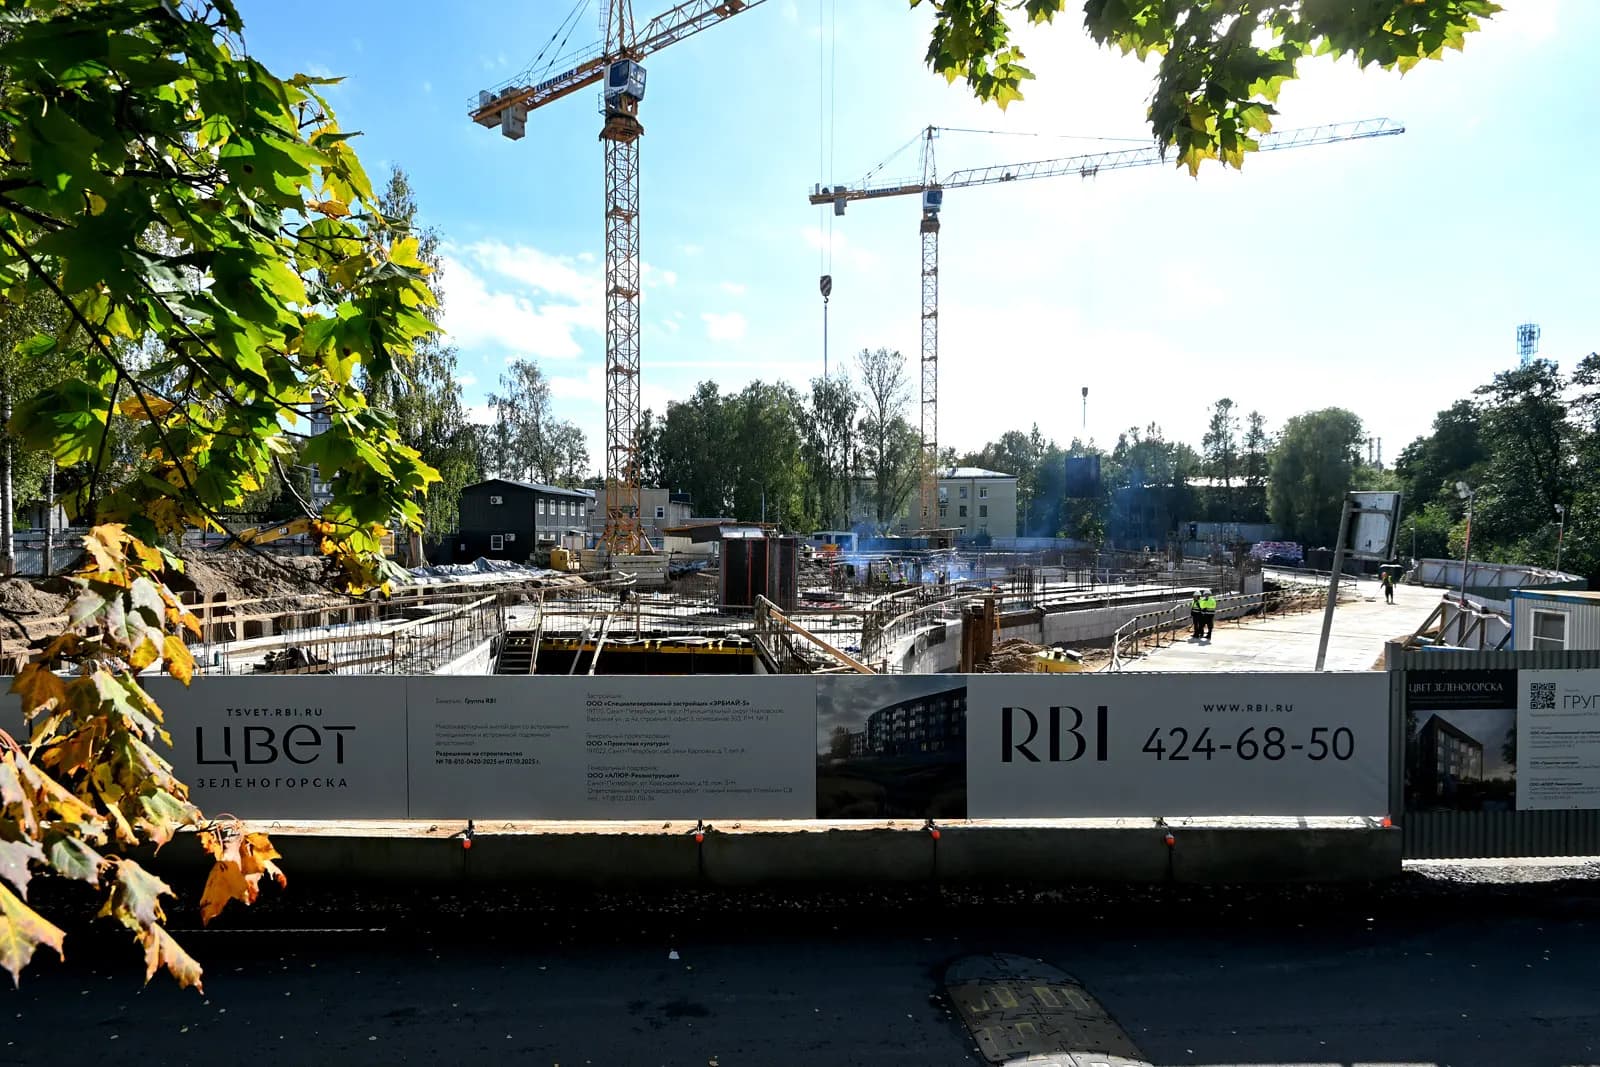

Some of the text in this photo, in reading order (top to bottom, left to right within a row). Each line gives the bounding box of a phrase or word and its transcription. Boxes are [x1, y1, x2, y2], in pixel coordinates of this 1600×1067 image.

[1408, 682, 1504, 693] ЦВЕТ ЗЕЛЕНОГОРСКА
[226, 708, 323, 716] TSVET.RBI.RU
[1203, 703, 1294, 712] WWW.RBI.RU
[1000, 705, 1108, 762] RBI
[1142, 726, 1355, 761] 424-68-50
[196, 778, 348, 788] ЗЕЛЕНОГОРСКА
